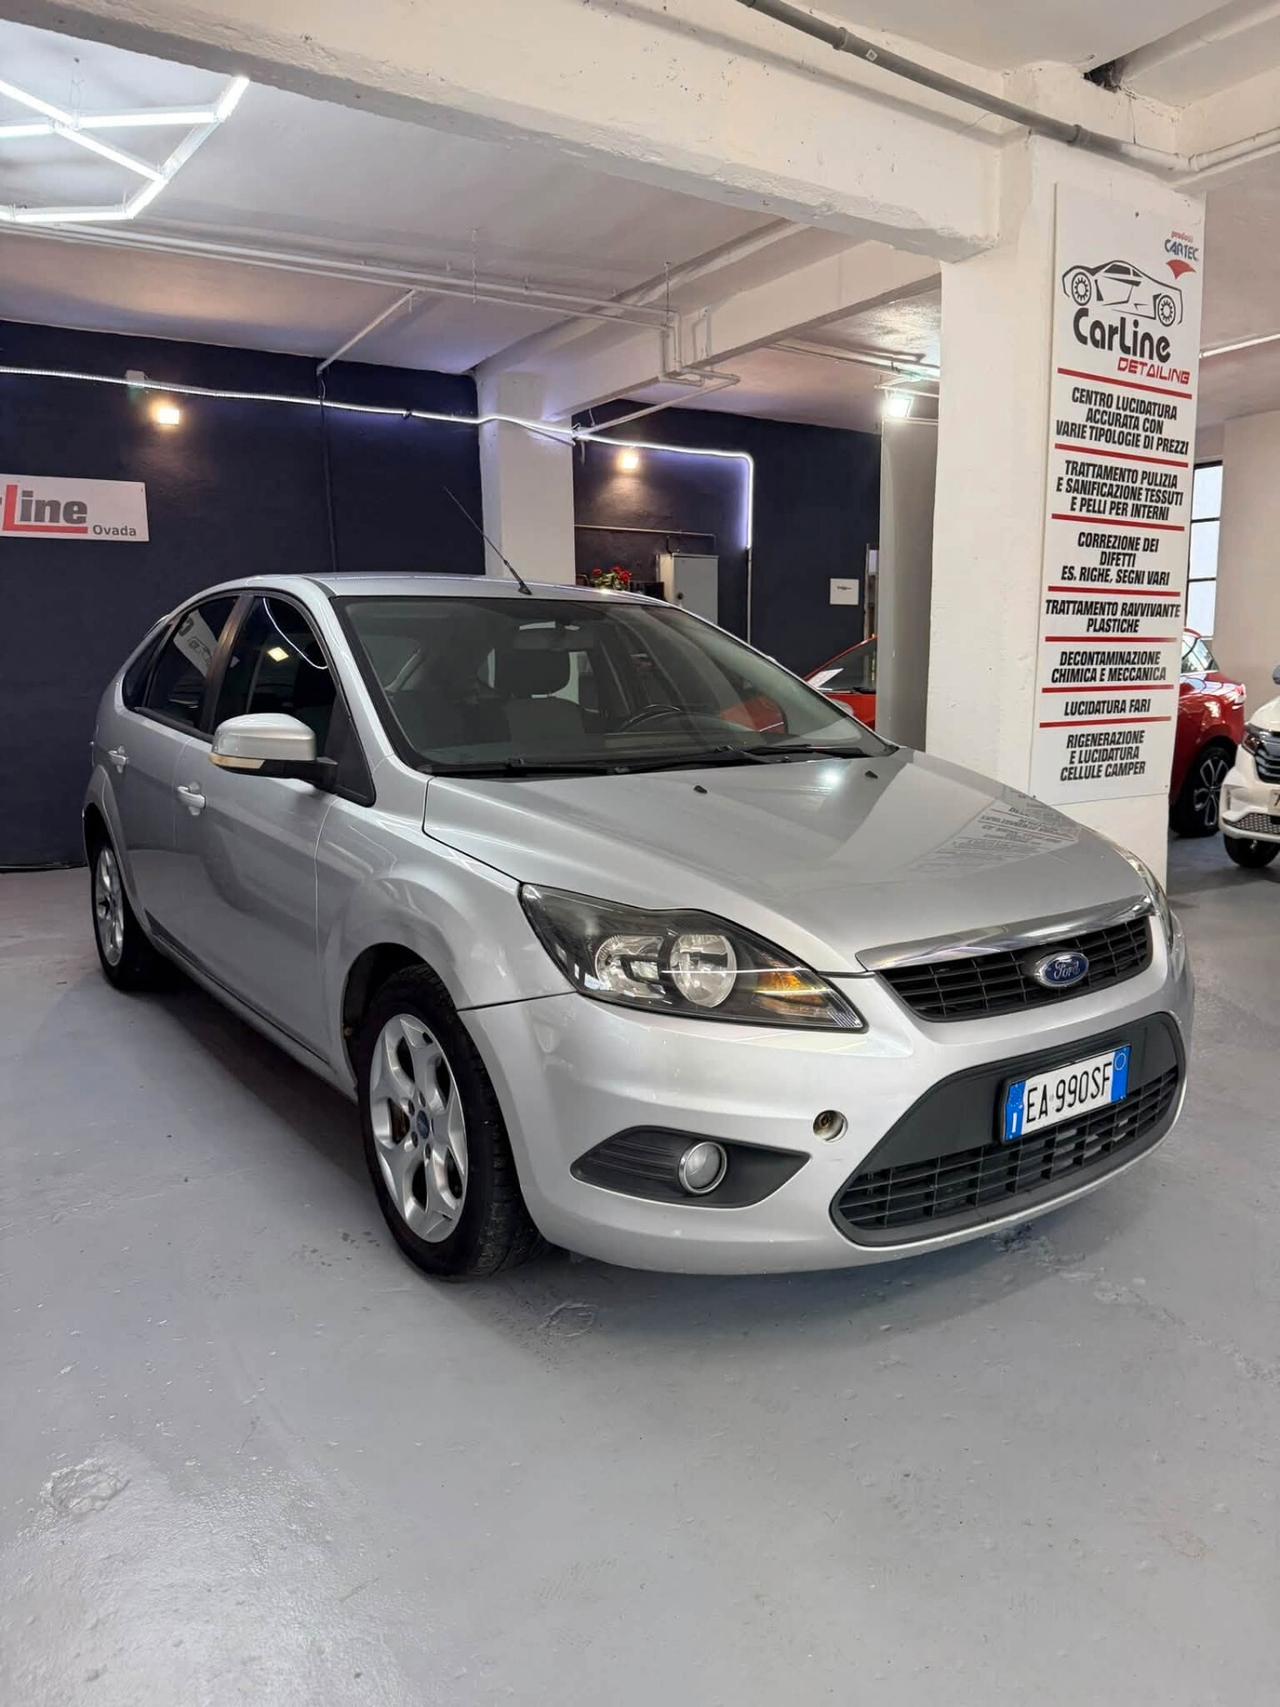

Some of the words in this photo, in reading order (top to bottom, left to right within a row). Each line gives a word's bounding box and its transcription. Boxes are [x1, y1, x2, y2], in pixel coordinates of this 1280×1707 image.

[1165, 239, 1199, 261] CARTEC
[1073, 307, 1171, 363] CarLine
[1117, 357, 1191, 385] DETAILING
[1071, 386, 1114, 409] CENTRO
[1115, 395, 1178, 421] LUCIDATURA
[1085, 407, 1140, 431] ACCURATA
[1142, 418, 1164, 435] CON
[1056, 419, 1088, 440] VARIE
[1089, 425, 1141, 448] TIPOLOGIE
[1143, 435, 1154, 451] DI
[1155, 436, 1190, 456] PREZZI
[1065, 459, 1139, 485] TRATTAMENTO
[1140, 470, 1178, 489] PULIZIA
[1056, 476, 1064, 492] E
[1065, 478, 1143, 503] SANIFICAZIONE
[1144, 488, 1184, 506] TESSUTI
[0, 484, 88, 533] Line
[1070, 496, 1078, 512] E
[1079, 497, 1107, 515] PELLI
[1109, 500, 1128, 518] PER
[1130, 503, 1170, 521] INTERNI
[92, 524, 137, 537] Ovada
[1077, 532, 1141, 549] CORREZIONE
[1142, 537, 1159, 552] DEI
[1099, 551, 1136, 568] DIFETTI
[1060, 565, 1077, 581] ES.
[1079, 566, 1113, 583] RIGHE,
[1115, 568, 1145, 585] SEGNI
[1147, 571, 1170, 586] VARI
[1045, 599, 1119, 617] TRATTAMENTO
[1120, 601, 1181, 618] RAVVIVANTE
[1086, 618, 1140, 633] PLASTICHE
[1059, 651, 1161, 667] DECONTAMINAZIONE
[1051, 668, 1097, 683] CHIMICA
[1099, 668, 1106, 682] E
[1107, 666, 1167, 682] MECCANICA
[1064, 699, 1127, 716] LUCIDATURA
[1129, 698, 1151, 713] FARI
[1066, 730, 1145, 749] RIGENERAZIONE
[1069, 751, 1077, 765] E
[1077, 746, 1140, 764] LUCIDATURA
[1060, 764, 1103, 781] CELLULE
[1104, 760, 1146, 778] CAMPER
[1053, 958, 1081, 980] Ford
[1055, 1061, 1113, 1113] 990SF
